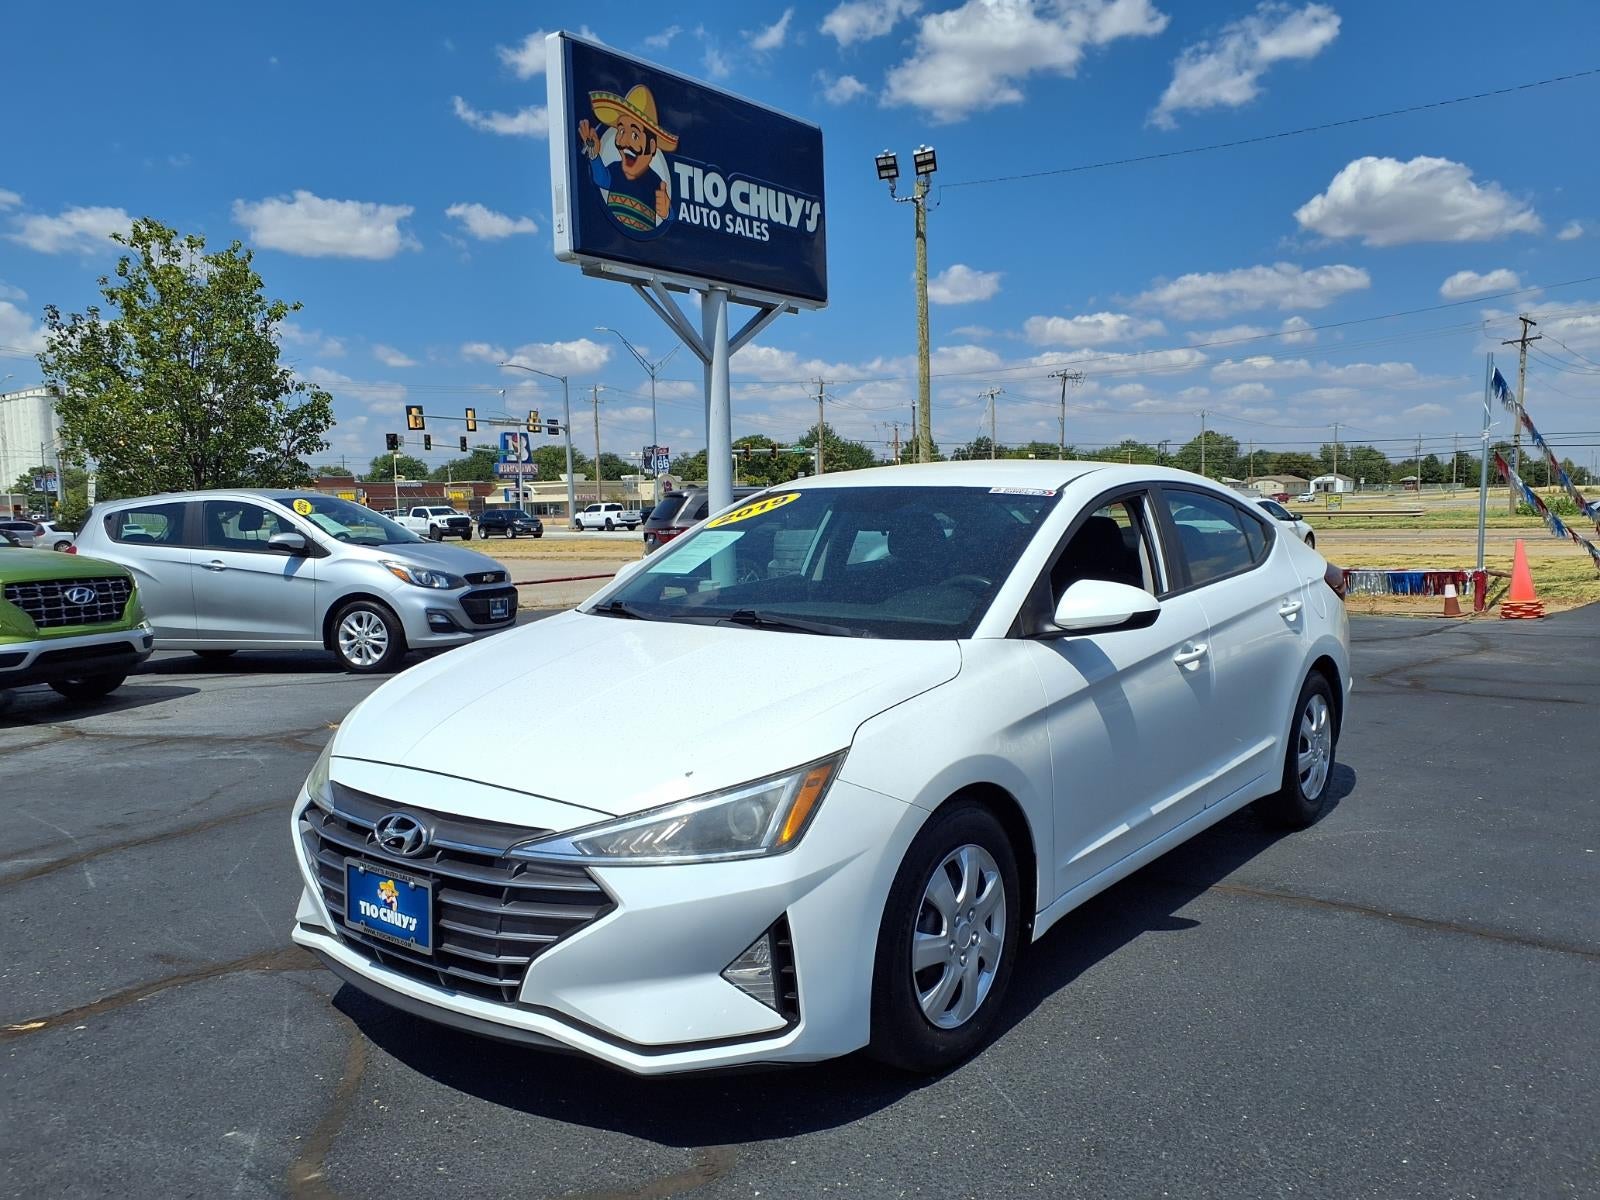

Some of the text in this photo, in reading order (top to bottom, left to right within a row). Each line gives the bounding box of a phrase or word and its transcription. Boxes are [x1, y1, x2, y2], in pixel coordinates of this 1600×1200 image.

[674, 161, 821, 233] TIO CHUY'S
[678, 202, 770, 242] AUTO SALES
[716, 496, 789, 526] 2019
[359, 900, 418, 932] TIO CHUY'S
